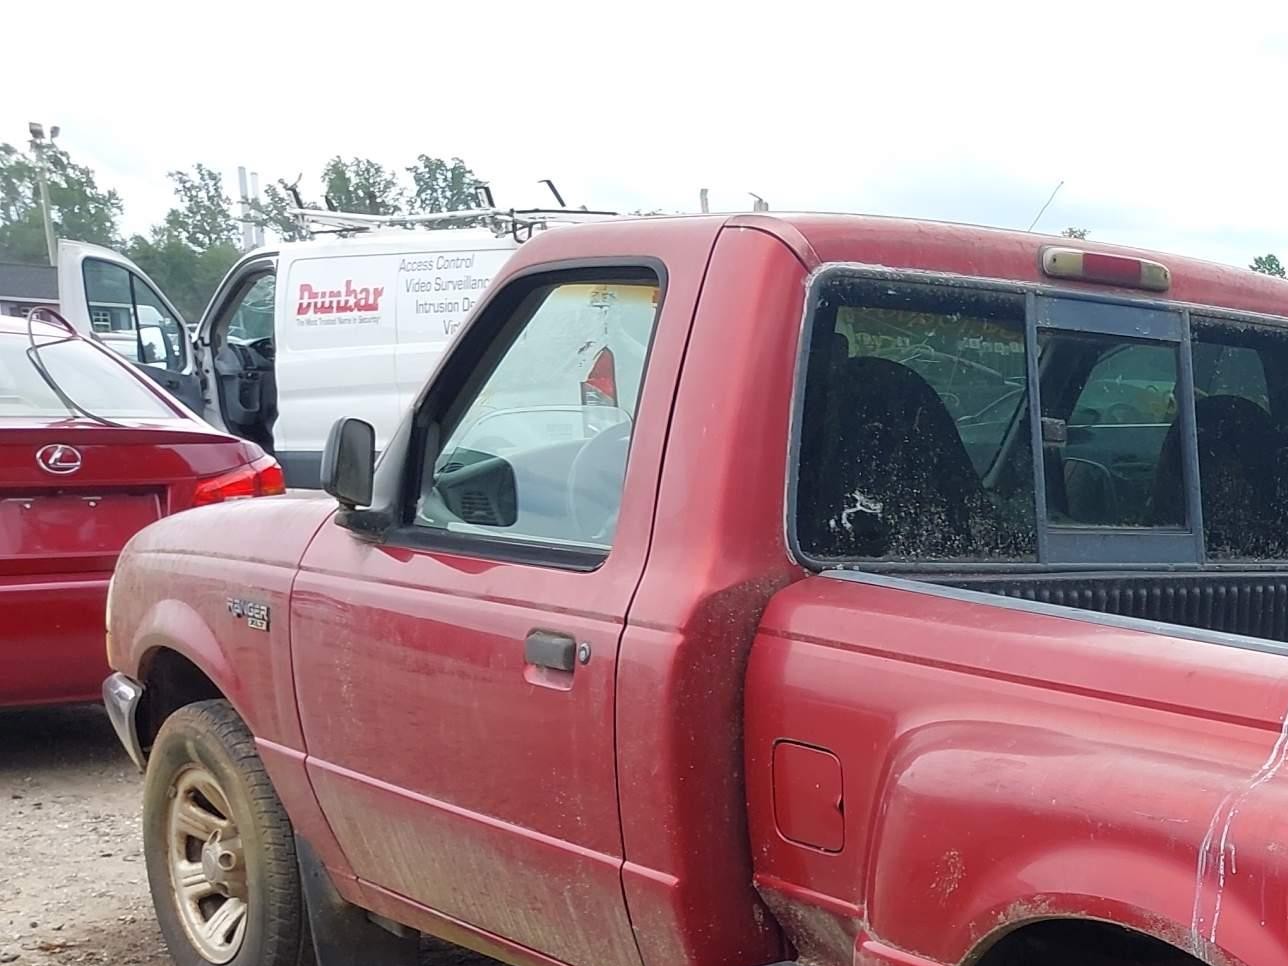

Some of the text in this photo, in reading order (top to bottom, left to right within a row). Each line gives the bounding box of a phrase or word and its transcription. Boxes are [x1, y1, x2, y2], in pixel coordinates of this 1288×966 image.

[399, 253, 475, 272] Access Control
[405, 278, 432, 293] Video
[297, 280, 384, 315] Dunbar
[416, 297, 459, 314] Intrusion
[226, 597, 269, 621] RANGER
